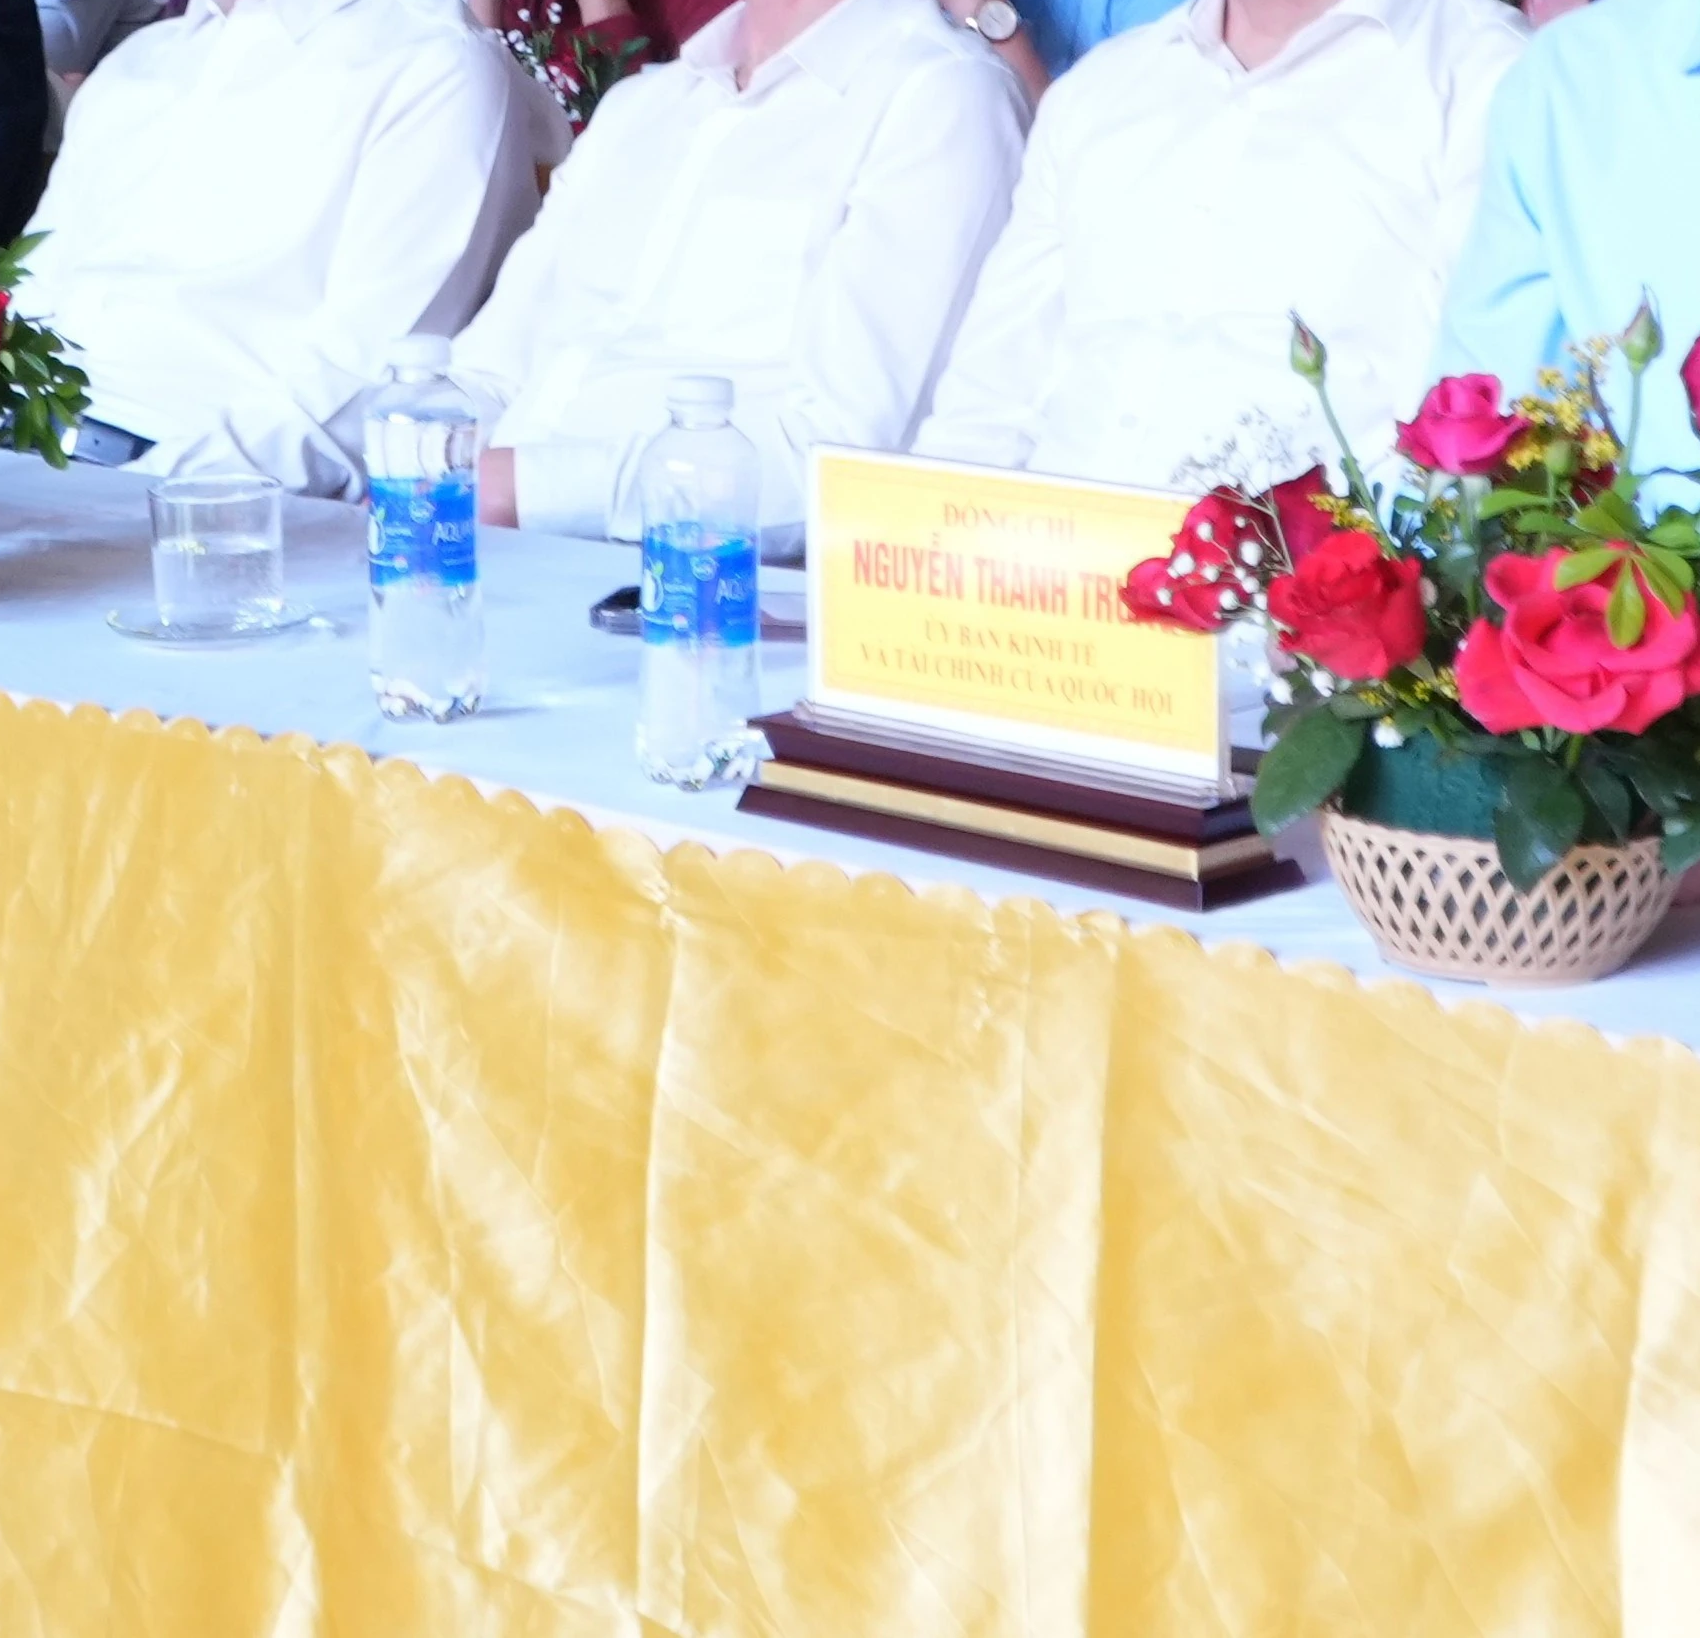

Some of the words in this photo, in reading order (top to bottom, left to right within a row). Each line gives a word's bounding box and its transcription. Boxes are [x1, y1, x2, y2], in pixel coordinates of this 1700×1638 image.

[943, 499, 1019, 535] ĐỒNG
[854, 532, 964, 600] NGUYỄN
[961, 624, 1002, 653] BAN
[1009, 633, 1064, 662] KINH
[1073, 639, 1096, 668] TẾ
[860, 637, 887, 668] VÀ
[896, 645, 927, 674] TÀI
[936, 654, 1004, 688] CHÍNH
[1011, 665, 1058, 695] CỦA
[1061, 675, 1125, 706] QUỐC
[1132, 683, 1174, 718] HỘI
